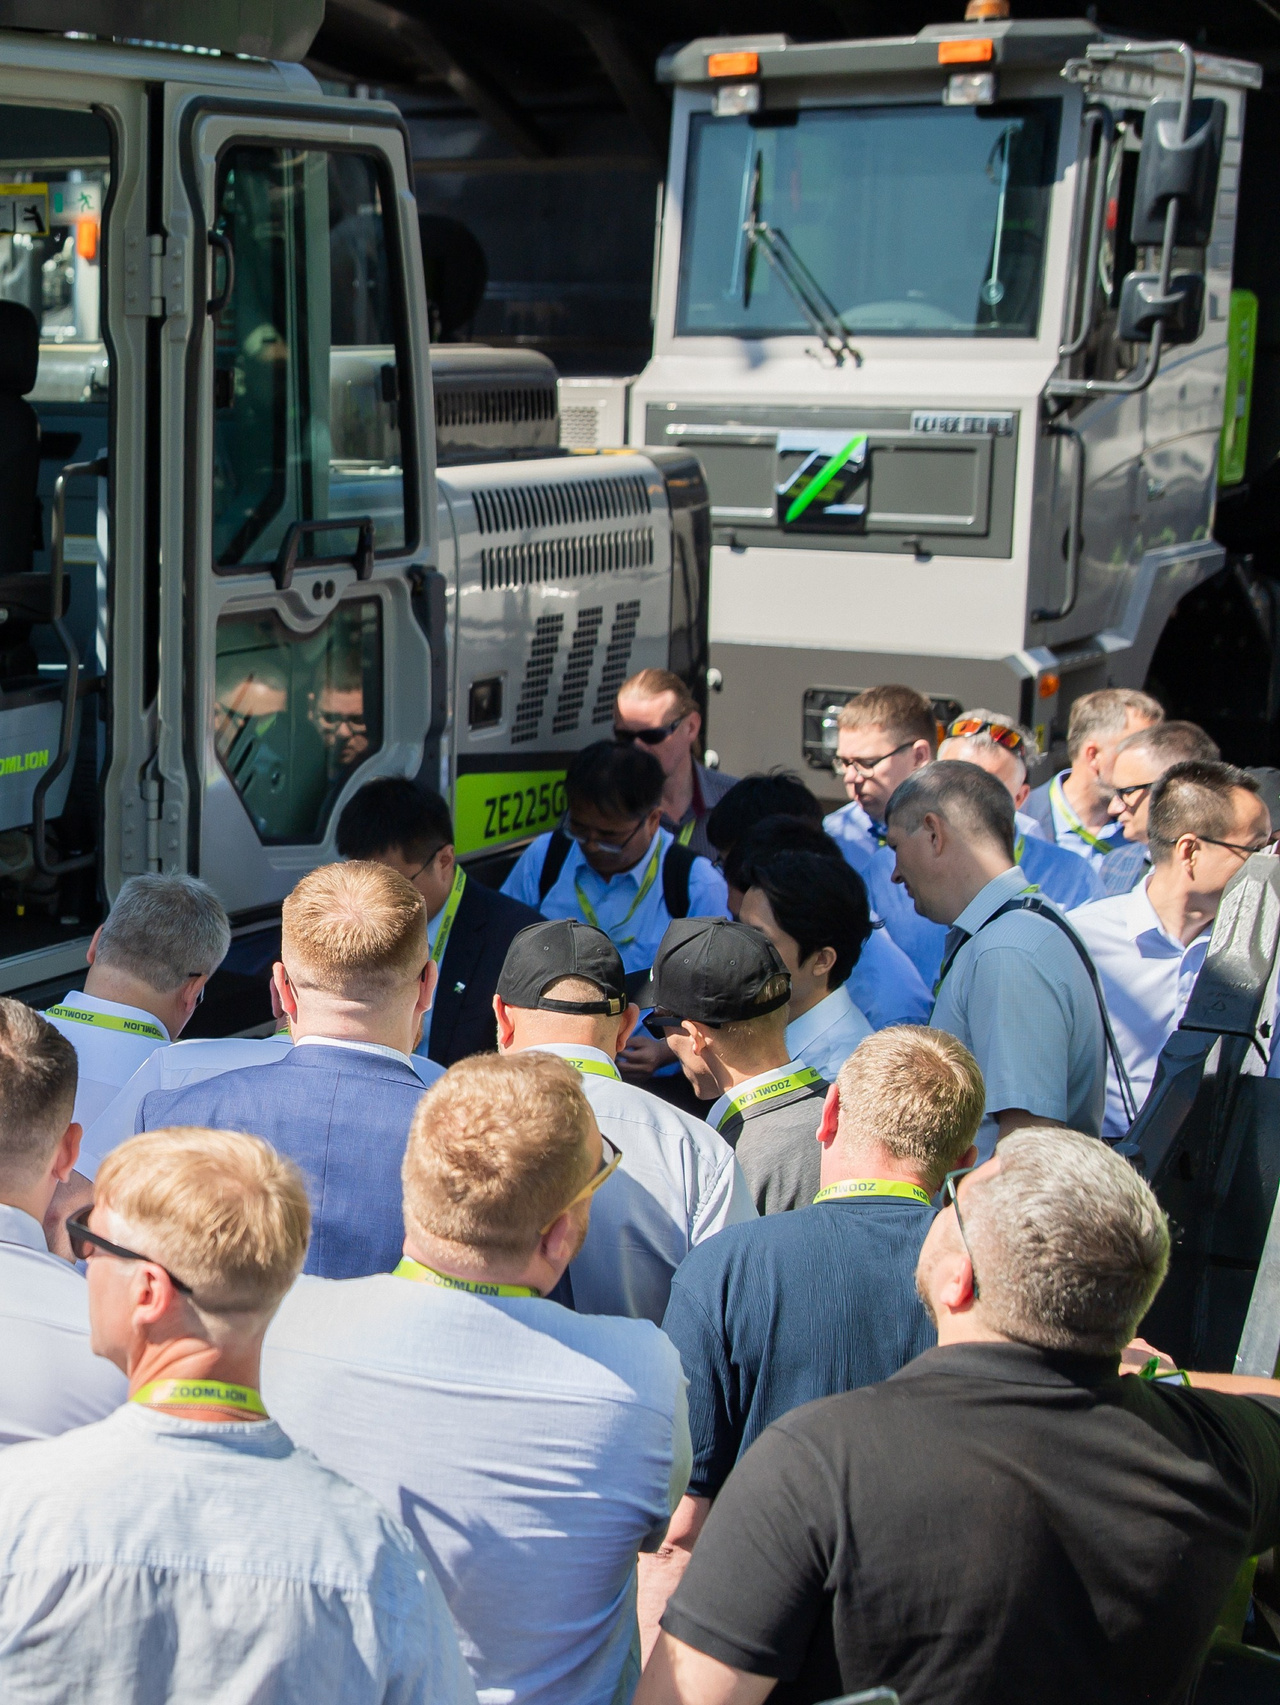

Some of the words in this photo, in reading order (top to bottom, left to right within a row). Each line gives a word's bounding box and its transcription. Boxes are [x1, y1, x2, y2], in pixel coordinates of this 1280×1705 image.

[739, 1080, 792, 1106] ZOOMLION
[817, 1182, 876, 1199] ZOOMLIO
[424, 1271, 500, 1296] ZOOMLION
[170, 1386, 248, 1402] ZOOMLION
